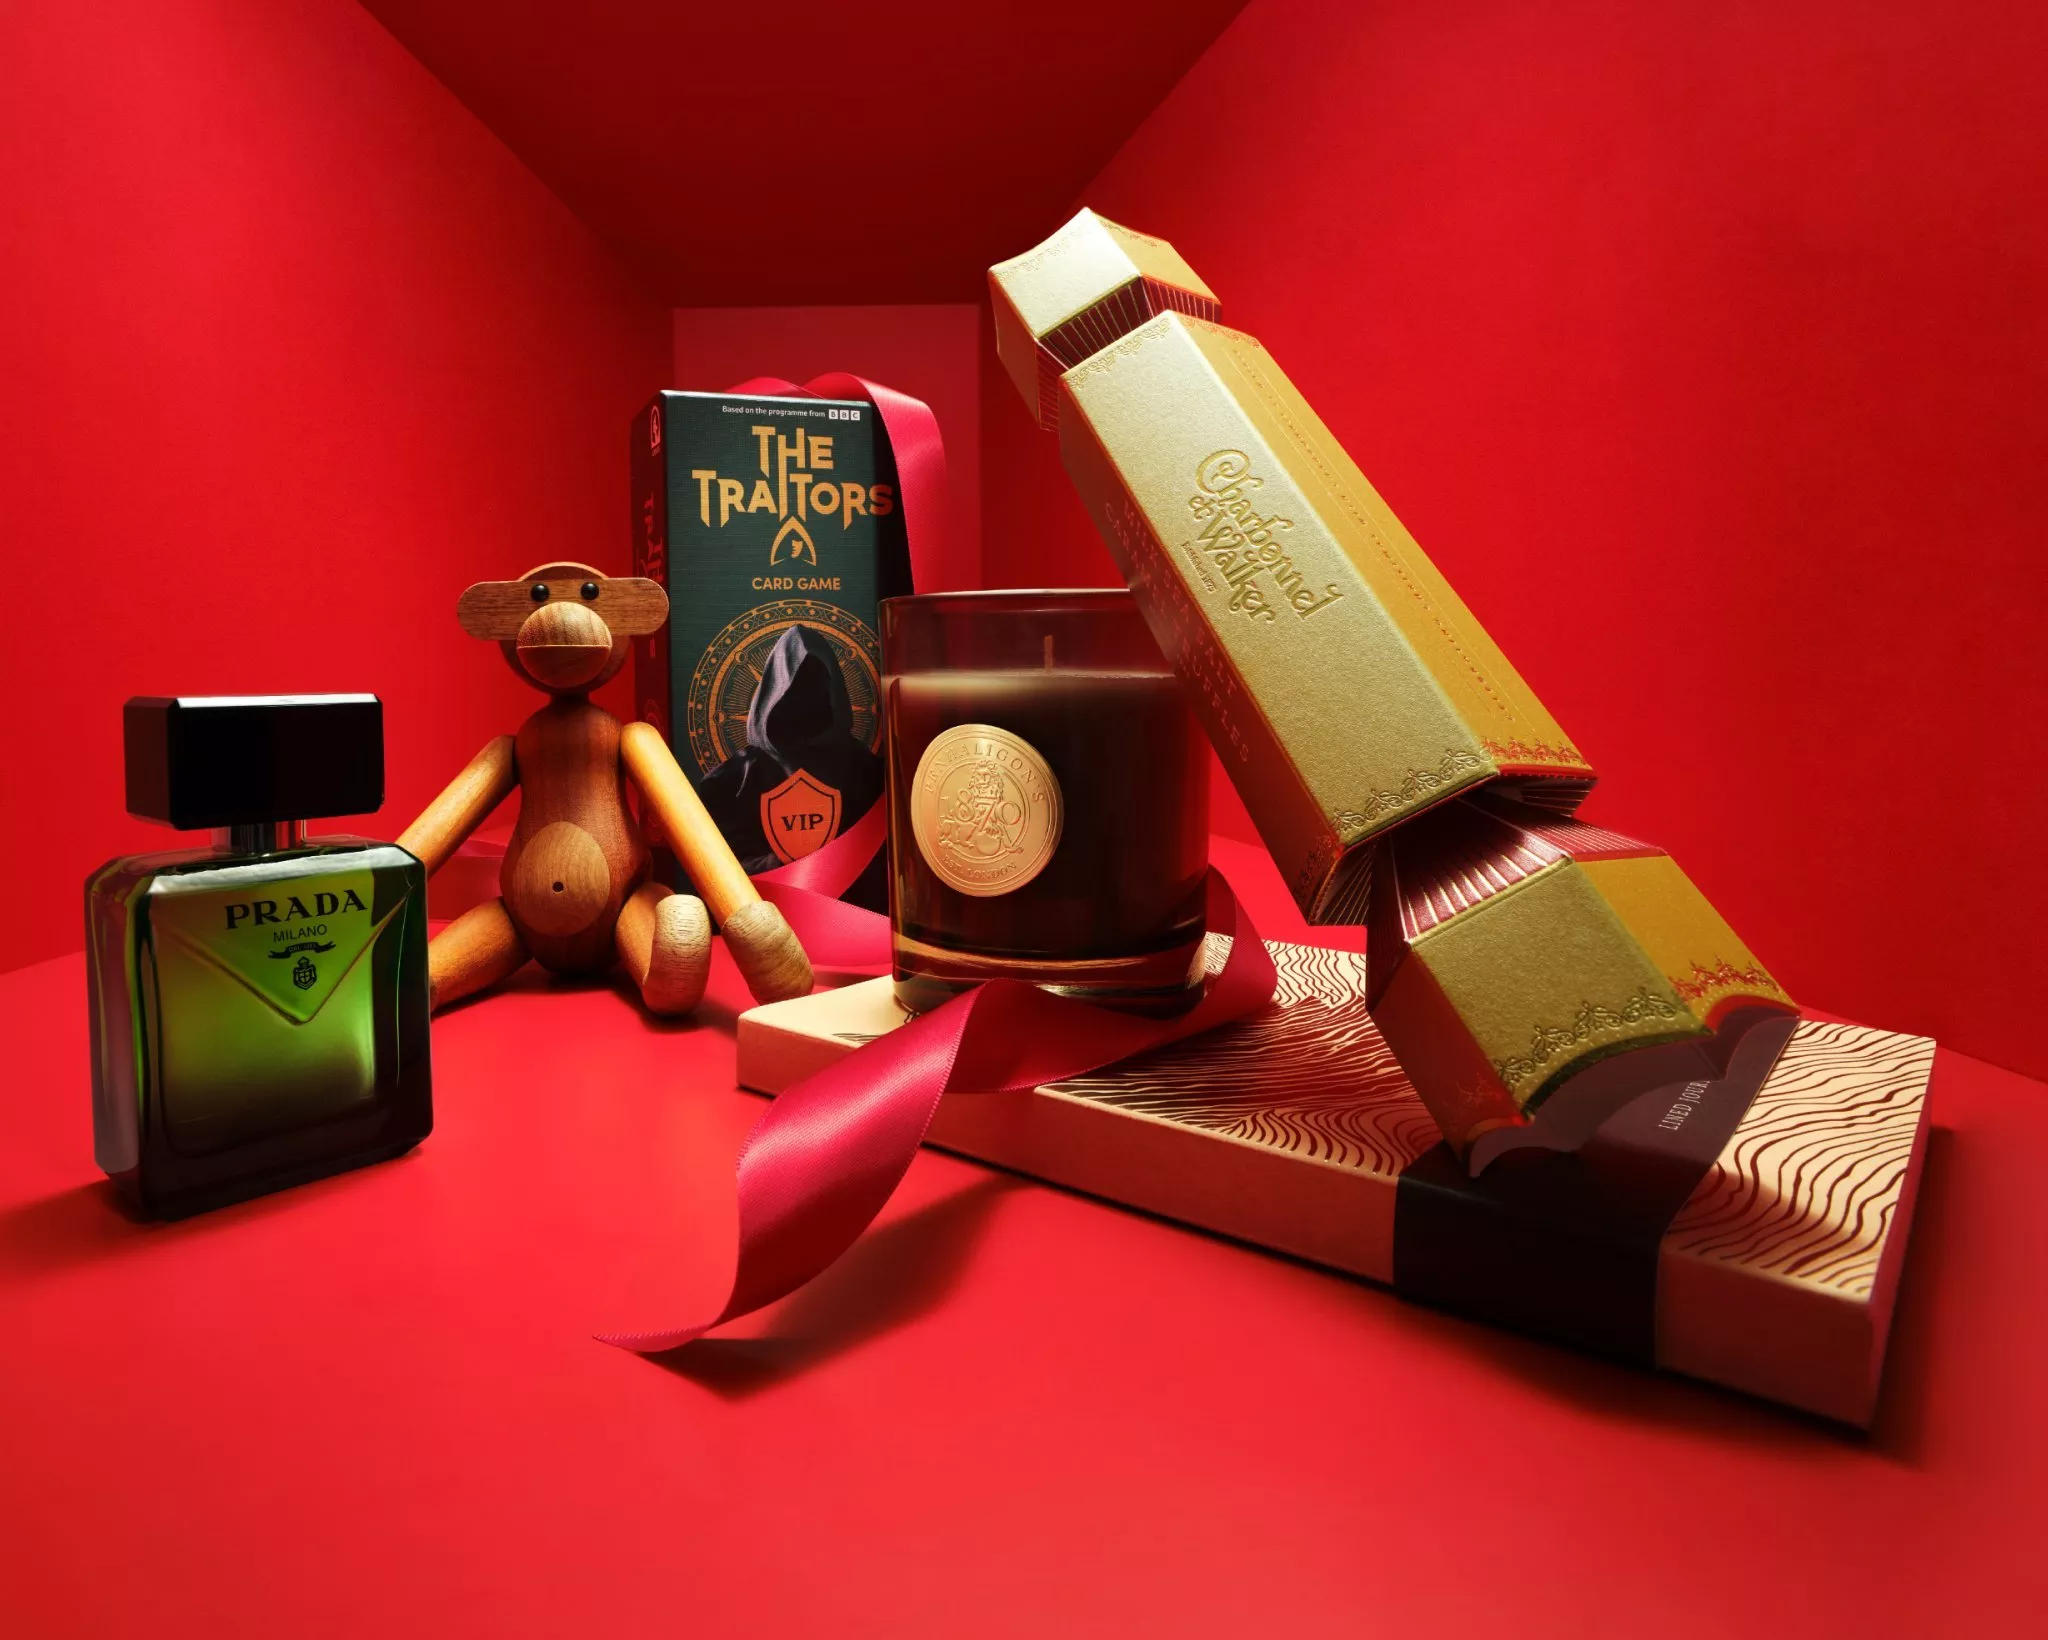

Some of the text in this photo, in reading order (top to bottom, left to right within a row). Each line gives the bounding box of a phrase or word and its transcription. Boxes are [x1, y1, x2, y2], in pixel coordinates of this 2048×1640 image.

[722, 405, 744, 414] Based
[755, 407, 767, 415] the
[768, 408, 808, 418] programme
[809, 409, 825, 418] from
[828, 409, 860, 421] BBC
[752, 425, 834, 479] THE
[691, 469, 893, 531] TRAITORS
[1196, 449, 1345, 620] Charbonnel
[752, 577, 841, 592] CARD GAME
[1196, 508, 1276, 622] Walker
[781, 813, 823, 832] VIP
[224, 889, 368, 929] PRADA
[273, 924, 328, 943] MILANO
[1658, 1080, 1710, 1131] LINED JOUR
